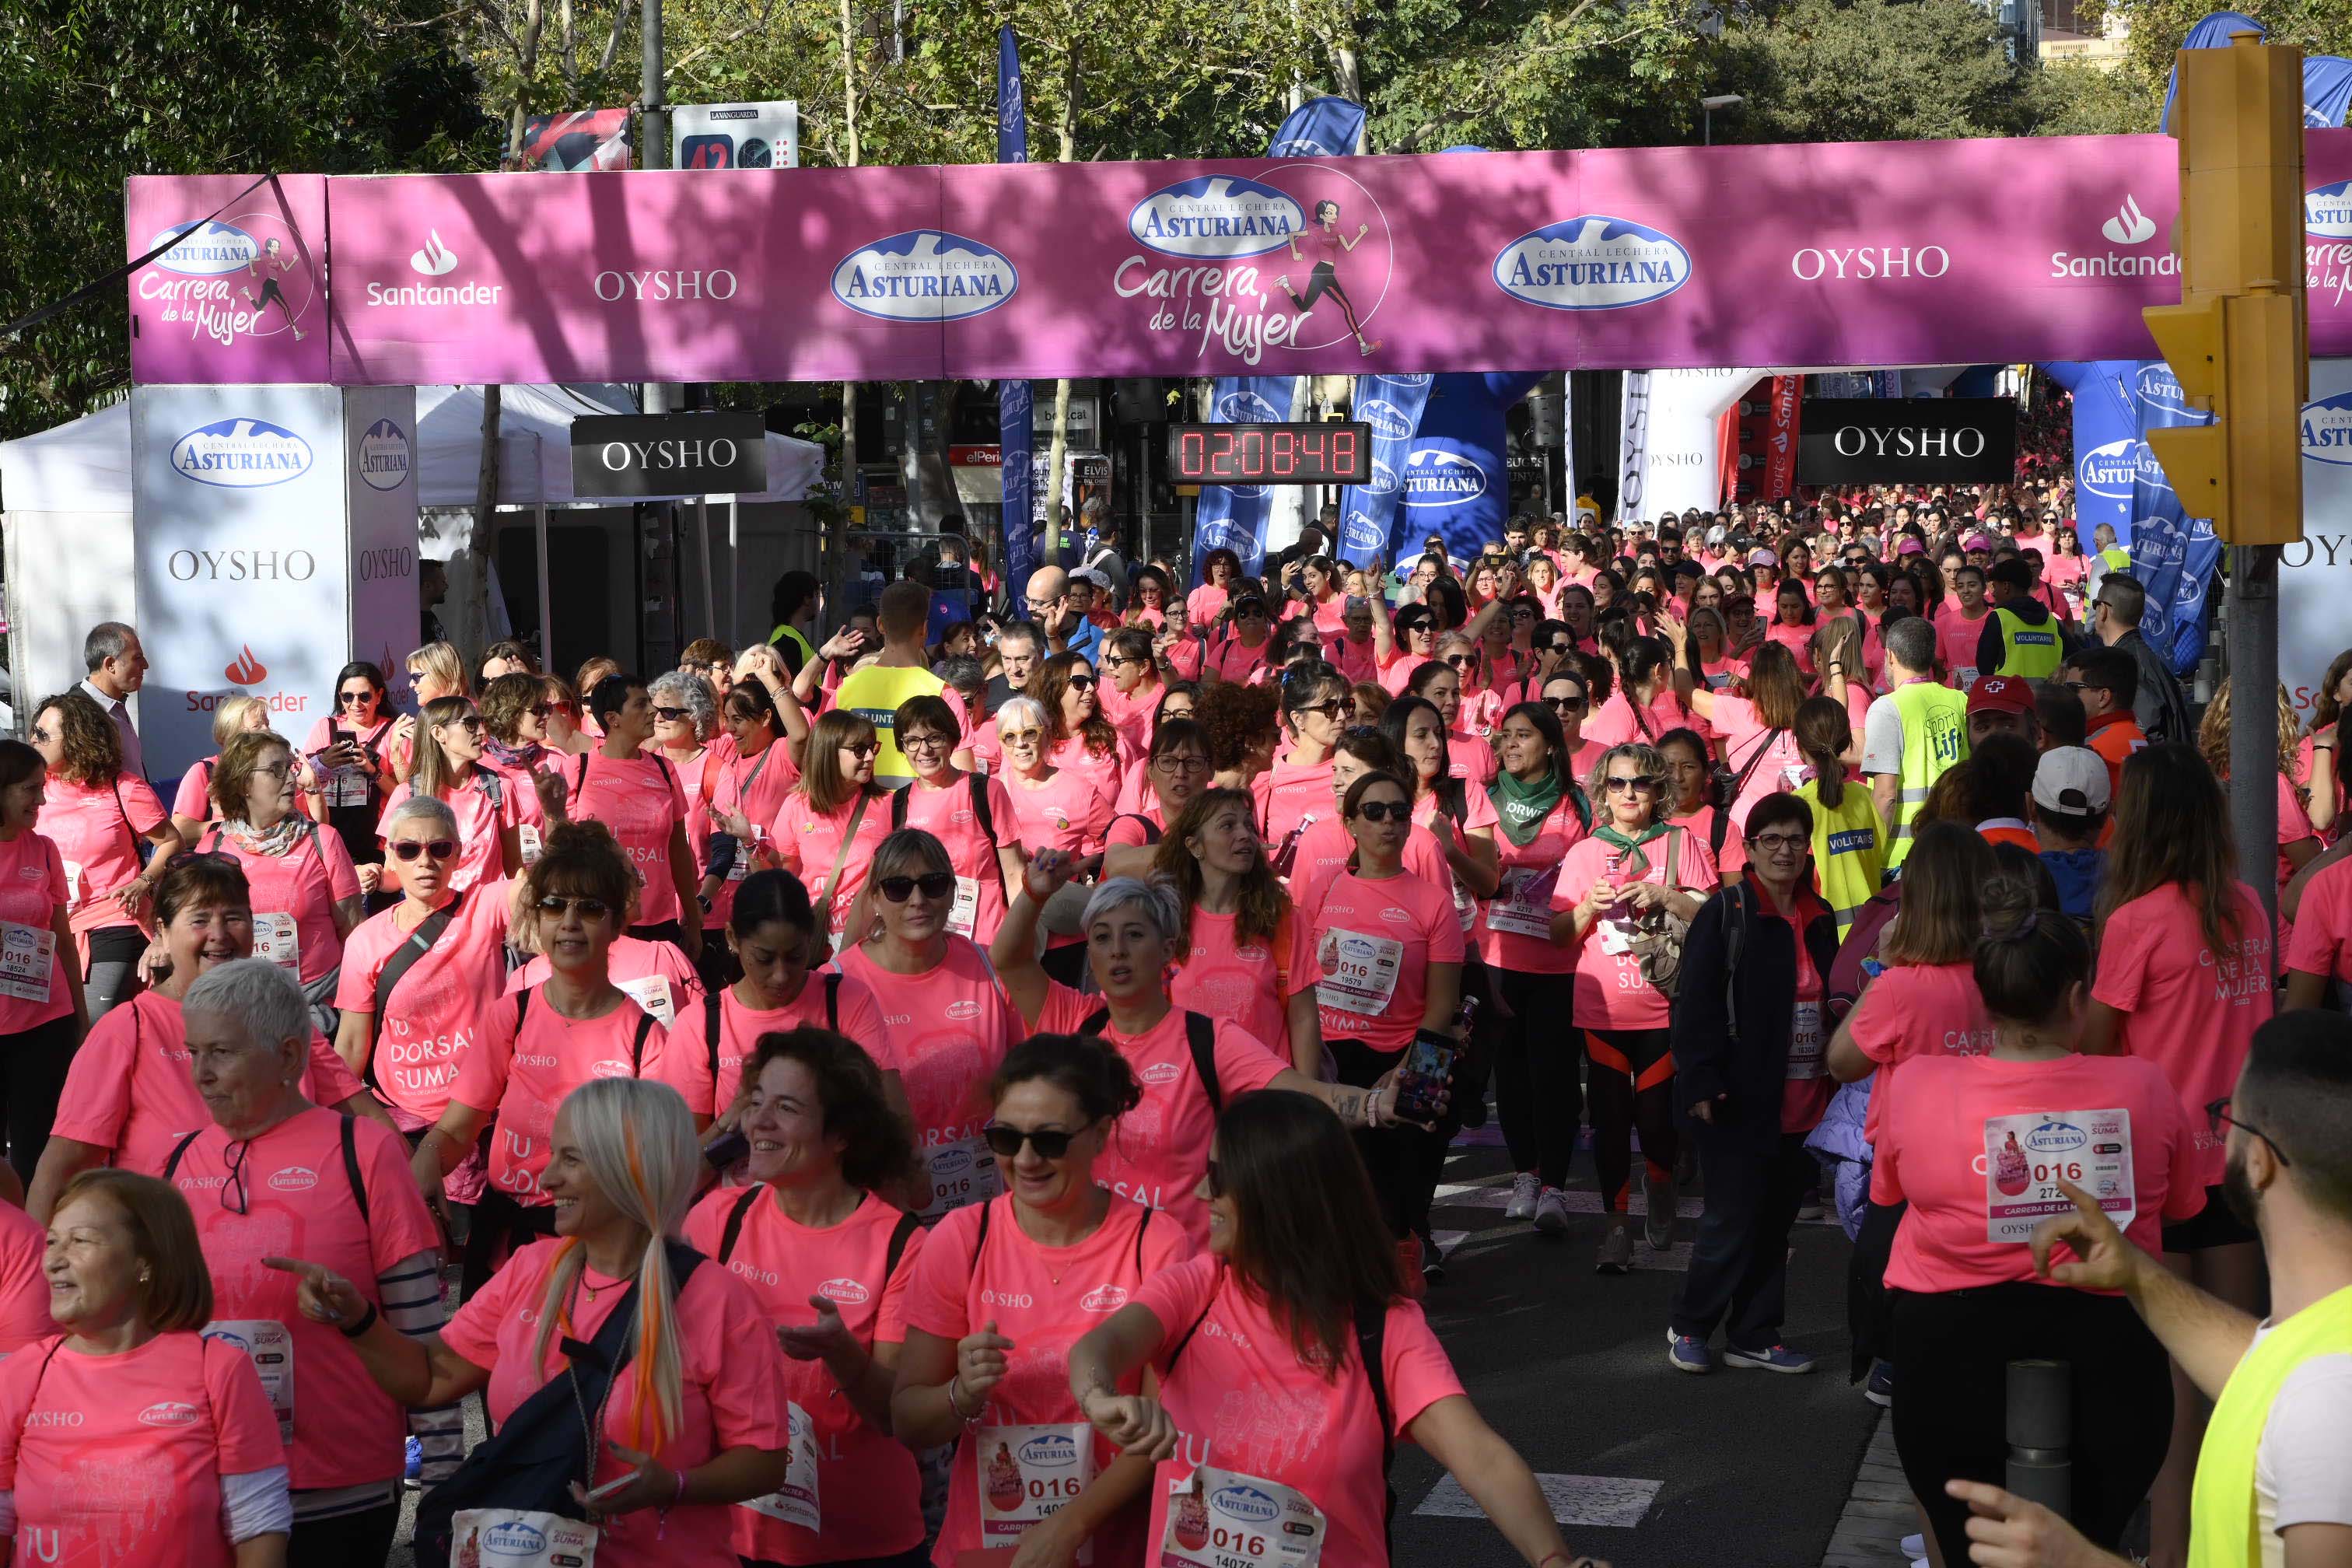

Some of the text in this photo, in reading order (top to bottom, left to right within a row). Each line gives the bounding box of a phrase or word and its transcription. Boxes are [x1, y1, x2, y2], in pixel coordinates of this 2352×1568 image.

[1169, 203, 1286, 213] CENTRAL LECHERA
[2305, 209, 2352, 225] ASTU
[1142, 206, 1291, 239] ASTURIANA
[1538, 247, 1669, 258] CENTRAL LECHERA
[1791, 245, 1951, 281] OYSHO
[874, 261, 997, 271] CENTRAL LECHERA
[1114, 255, 1259, 299] Carrera
[1509, 252, 1676, 287] ASTURIANA
[138, 271, 229, 301] Carrera
[367, 280, 502, 306] Santander
[594, 269, 737, 302] OYSHO
[845, 264, 1003, 299] ASTURIANA
[161, 298, 264, 346] de la Mujer
[1149, 292, 1313, 366] de la Mujer
[1834, 425, 1985, 457] OYSHO
[181, 444, 303, 471] ASTURIANA
[362, 444, 408, 474] ASTURIANA
[602, 438, 737, 471] OYSHO
[1181, 432, 1355, 475] 02:08:48
[1083, 466, 1108, 475] ELVIS
[169, 549, 315, 581] OYSHO
[359, 546, 411, 582] OYSHO
[1926, 713, 1957, 738] Sport
[5, 950, 30, 965] 016
[1340, 961, 1367, 977] 016
[1341, 975, 1362, 986] 19579
[2215, 975, 2269, 1001] MUJER
[1795, 1032, 1817, 1044] 016
[719, 1055, 743, 1069] OYS
[395, 1062, 460, 1089] SUMA
[505, 1129, 530, 1158] TU
[2030, 1135, 2082, 1148] ASTURIANA
[180, 1176, 227, 1189] OYSHO
[2034, 1163, 2082, 1182] 016
[936, 1178, 970, 1198] 016
[2005, 1206, 2042, 1216] CARRERA
[2001, 1222, 2034, 1235] OYSH
[821, 1284, 865, 1301] ASTURIANA
[981, 1289, 1033, 1309] OYSHO
[254, 1335, 282, 1345] SUMA
[1024, 1447, 1076, 1461] ASTURIAN
[1028, 1477, 1081, 1500] 016
[1214, 1497, 1314, 1518] ASTURIANA SUMA
[25, 1525, 60, 1563] TU
[487, 1534, 541, 1552] ASTURIANA
[553, 1535, 584, 1547] SUMA
[1213, 1528, 1265, 1556] 016
